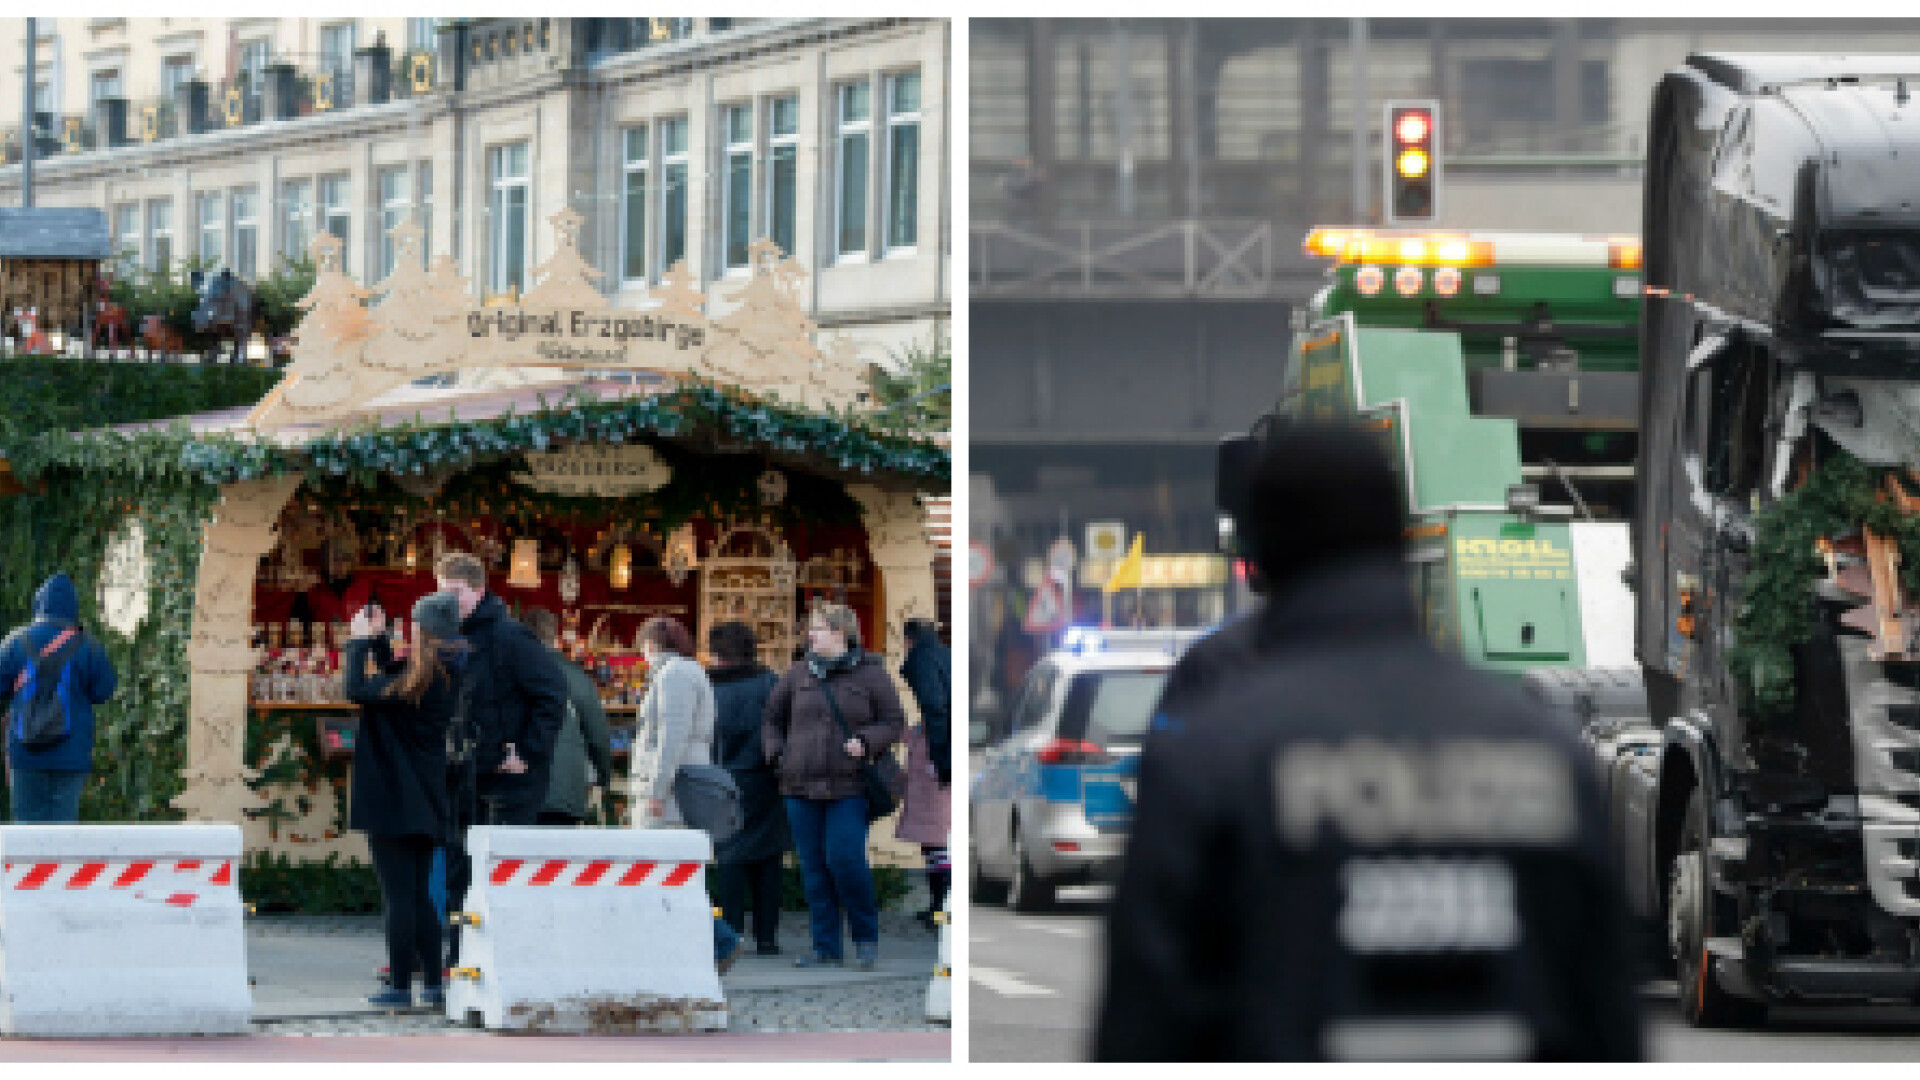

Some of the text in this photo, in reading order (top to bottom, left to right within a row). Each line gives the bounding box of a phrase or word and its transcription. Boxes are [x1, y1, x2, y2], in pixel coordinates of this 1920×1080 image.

[467, 311, 706, 350] Original Erzgebirge
[1274, 740, 1576, 848] POLIZEI
